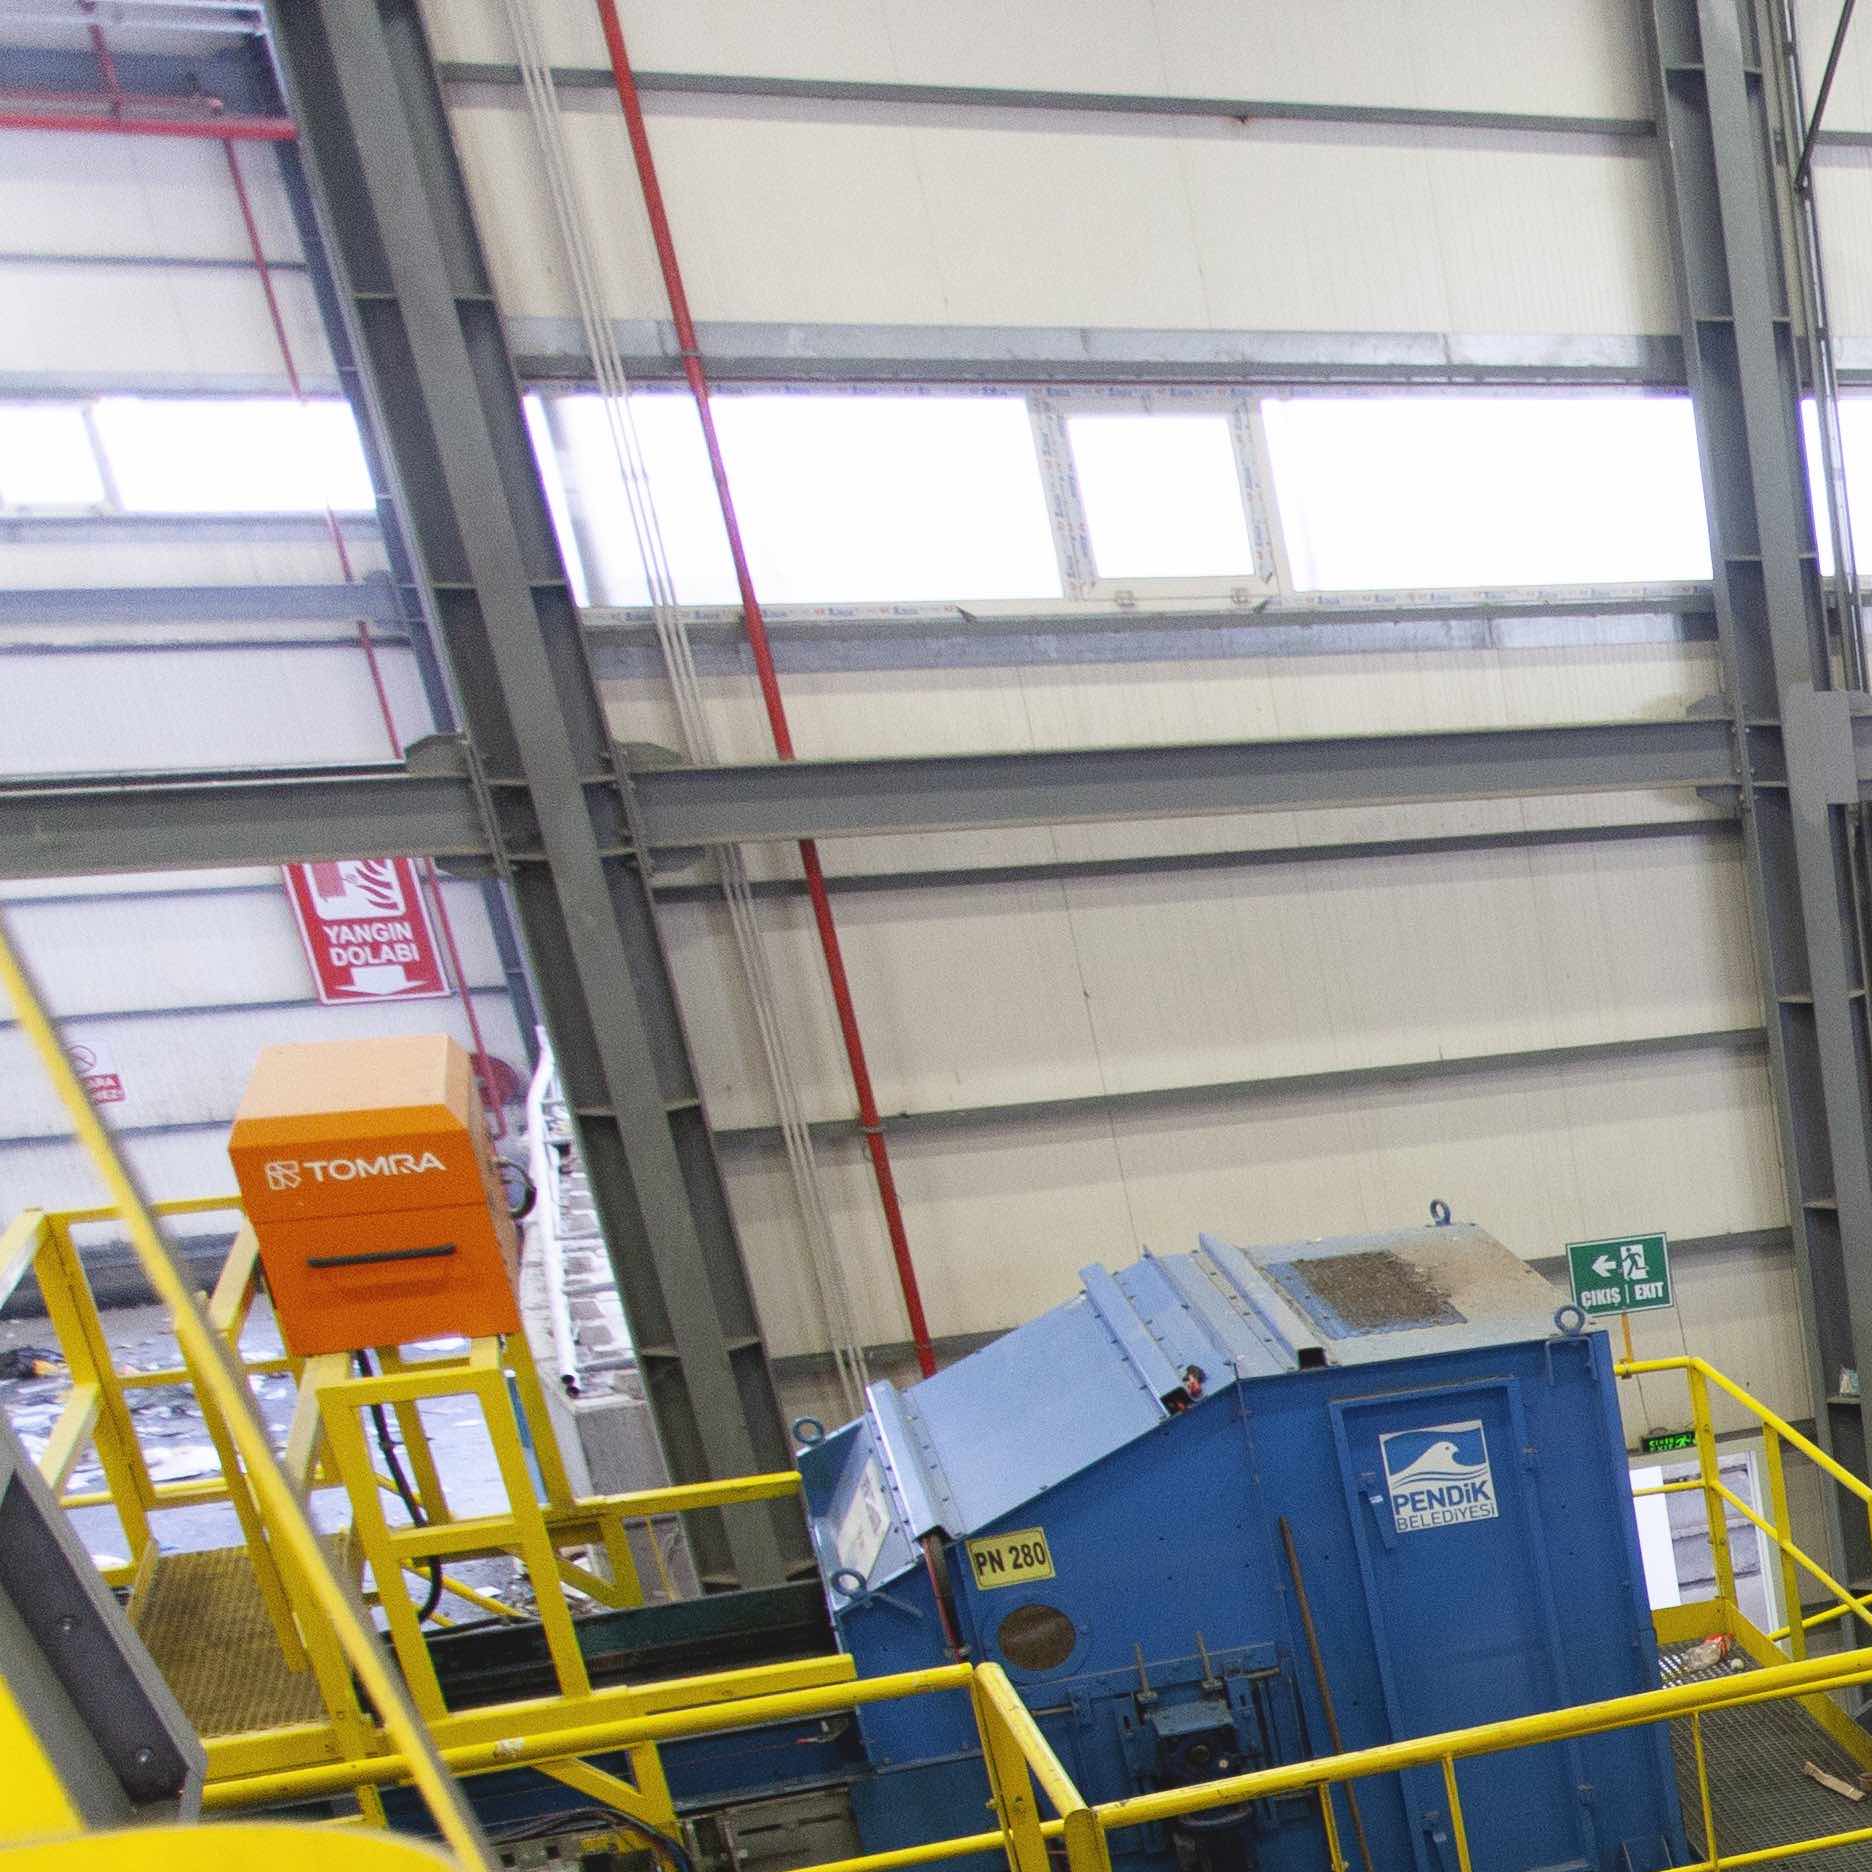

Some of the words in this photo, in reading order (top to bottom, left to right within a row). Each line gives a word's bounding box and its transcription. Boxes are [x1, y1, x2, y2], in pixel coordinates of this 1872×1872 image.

[323, 921, 414, 945] YANGIN
[329, 942, 420, 967] DOLABI
[303, 1152, 448, 1182] TOMRA
[1634, 1282, 1664, 1300] EXIT
[974, 1548, 1006, 1577] PN
[1008, 1541, 1046, 1570] 280
